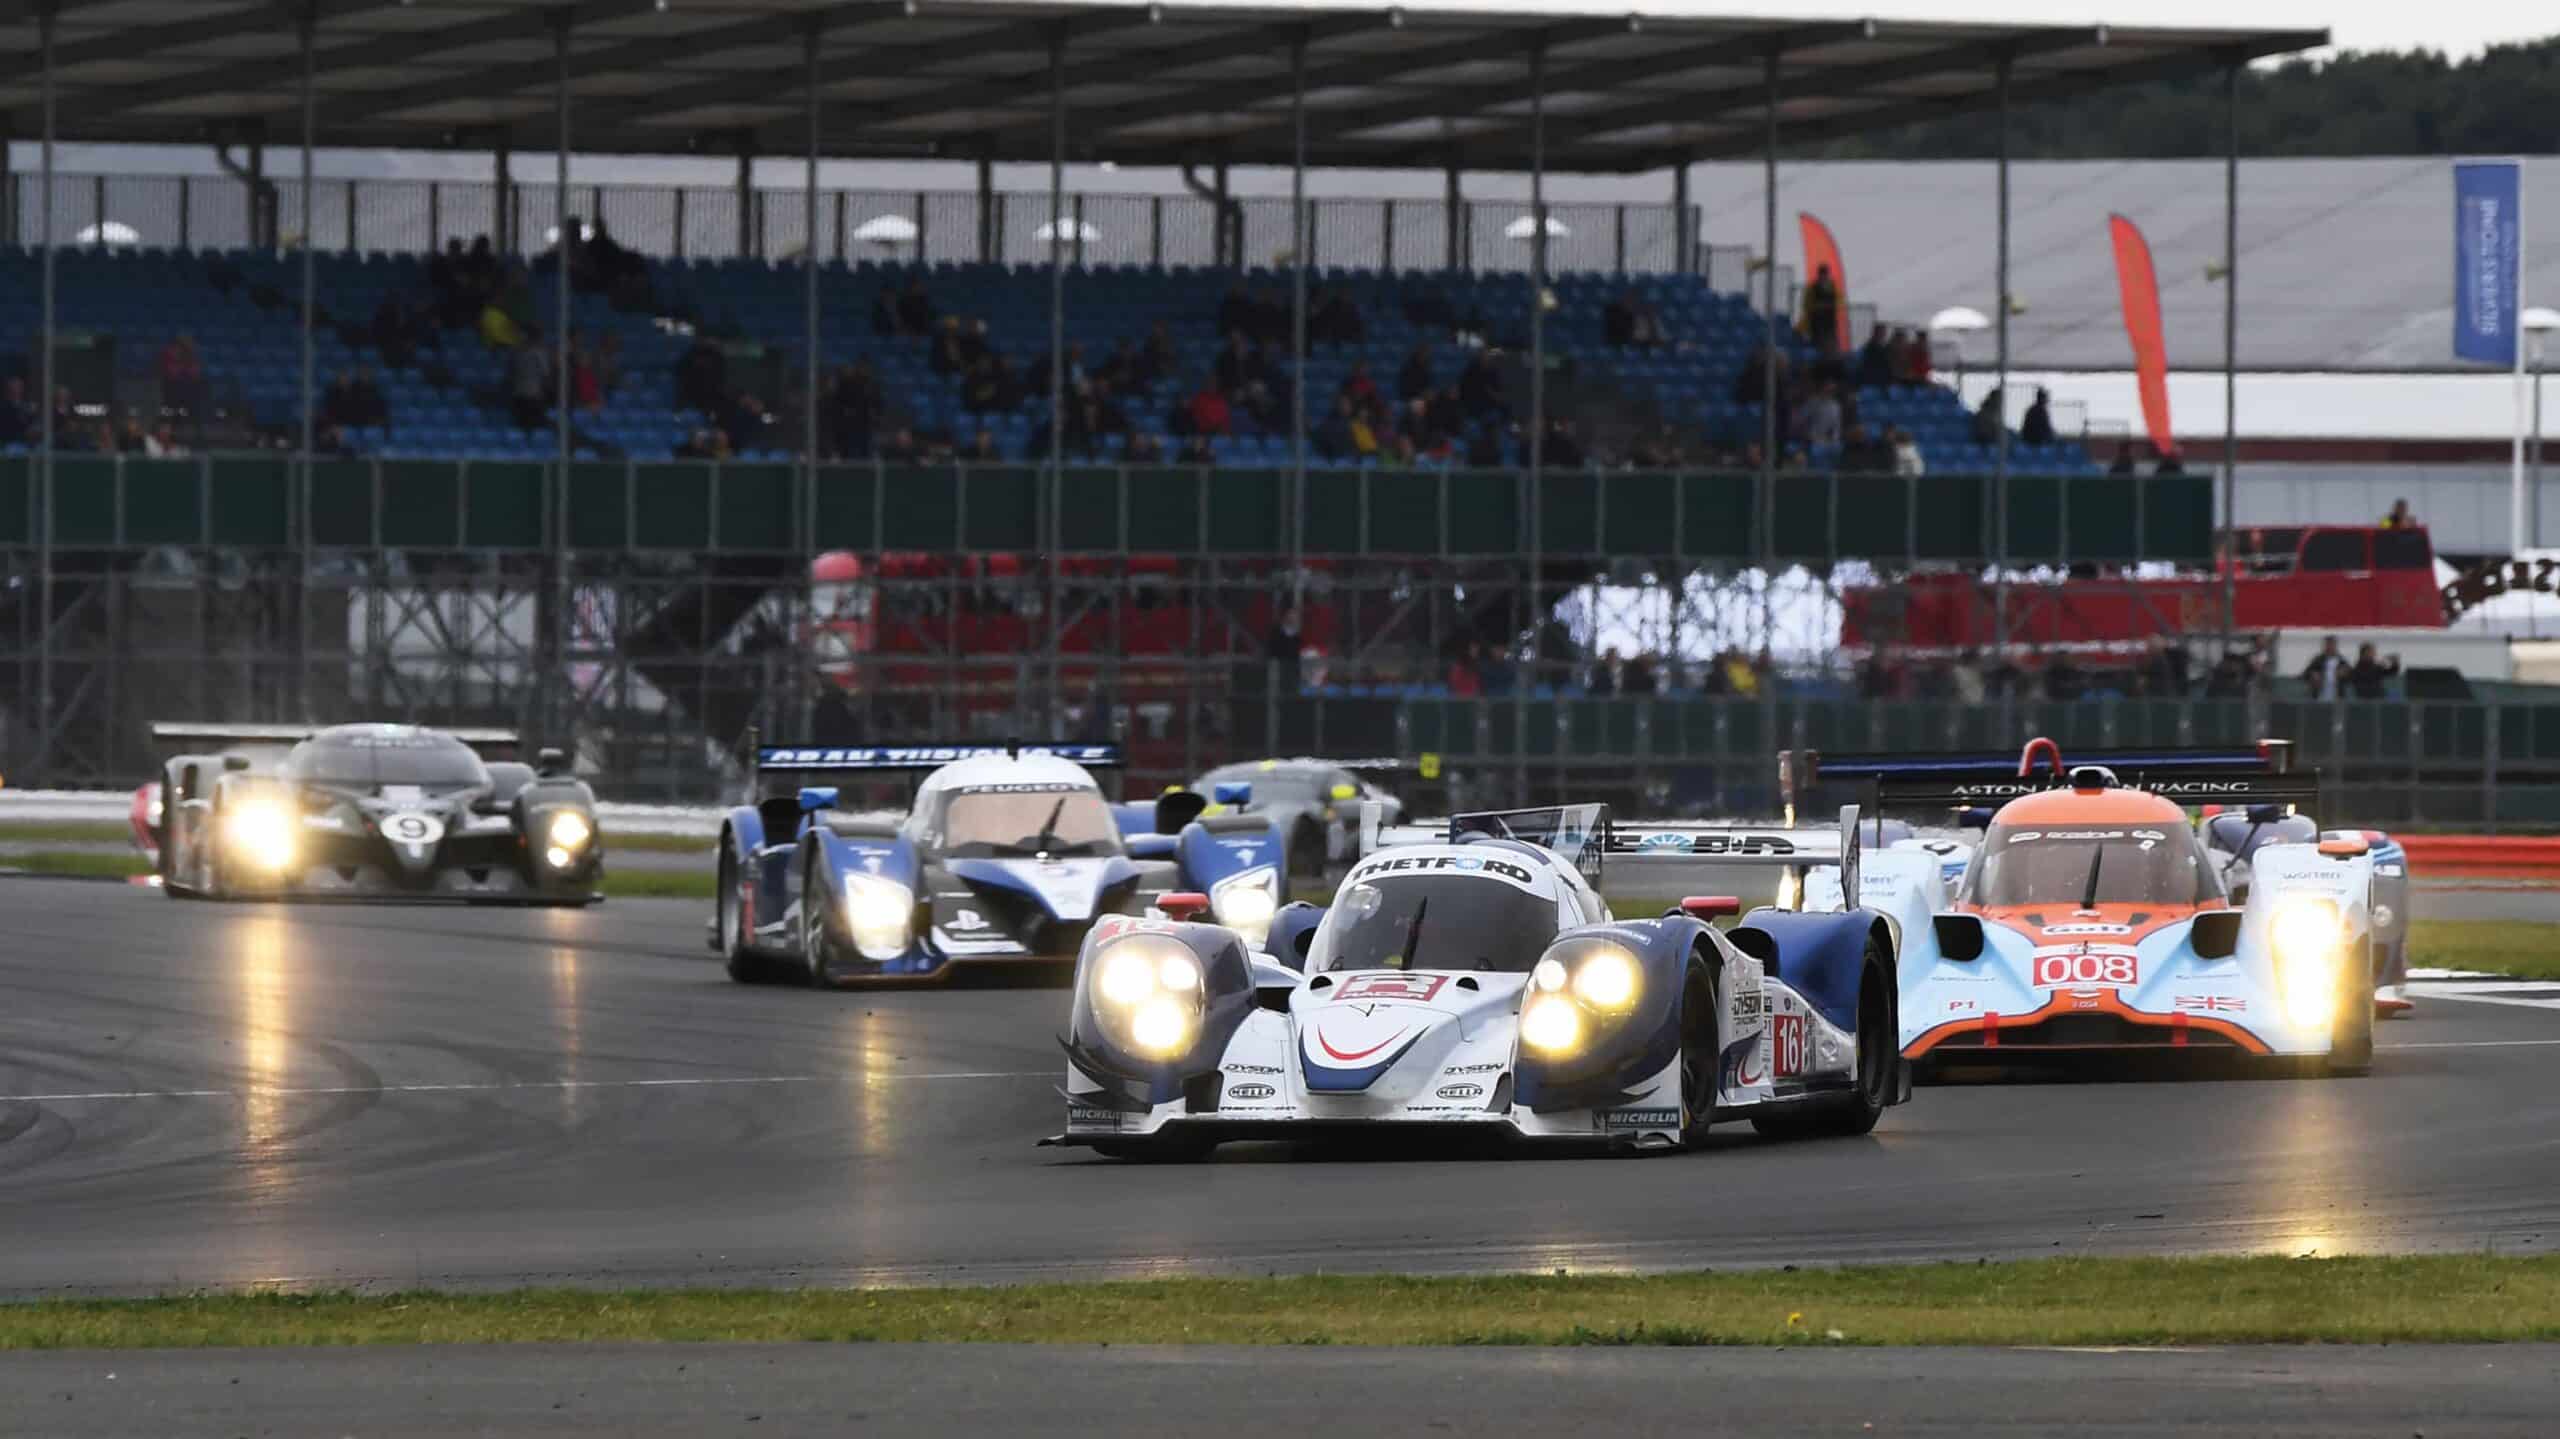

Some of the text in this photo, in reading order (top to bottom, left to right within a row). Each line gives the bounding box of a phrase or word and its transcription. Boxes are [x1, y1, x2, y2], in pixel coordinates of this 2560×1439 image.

[961, 783, 1081, 794] PEUGEOT
[1951, 784, 2037, 795] ASTON
[2150, 781, 2249, 792] RACING
[398, 817, 427, 840] 9
[1353, 857, 1532, 883] THETFORD
[2041, 955, 2134, 984] 008
[1949, 1001, 1976, 1010] P1
[1780, 1017, 1799, 1073] 16
[1225, 1064, 1284, 1074] DYSON
[1443, 1063, 1504, 1074] DYSON
[1608, 1112, 1678, 1123] MICHELIN
